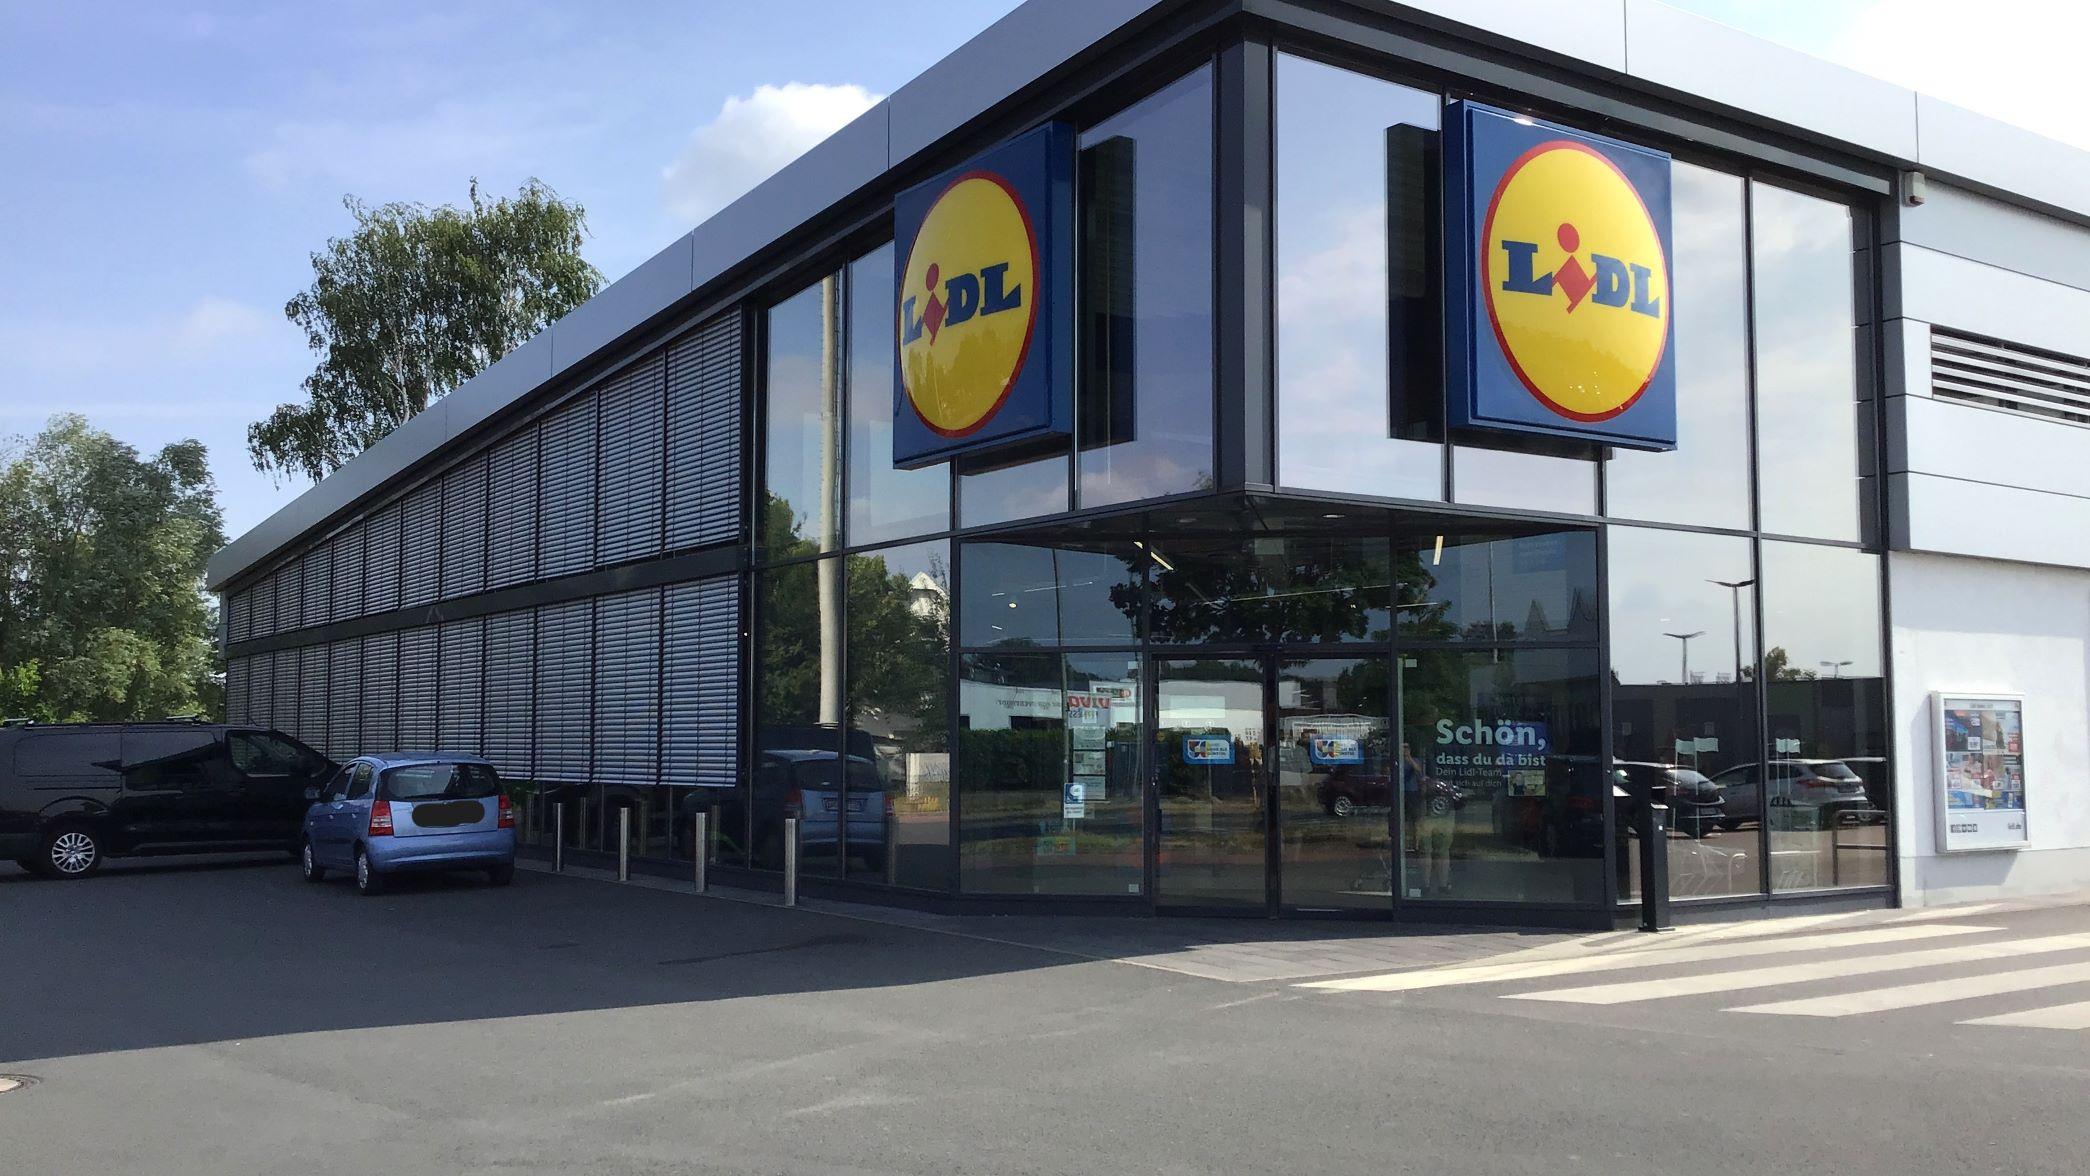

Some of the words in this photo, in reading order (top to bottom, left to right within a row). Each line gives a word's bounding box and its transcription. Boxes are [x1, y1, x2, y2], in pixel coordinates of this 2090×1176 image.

[1436, 718, 1547, 751] Schön,
[1436, 752, 1469, 765] dass
[1473, 753, 1493, 765] du
[1495, 753, 1515, 766] da
[1518, 753, 1547, 767] bist
[1436, 767, 1457, 776] Dein
[1459, 767, 1503, 778] Lidl-Team
